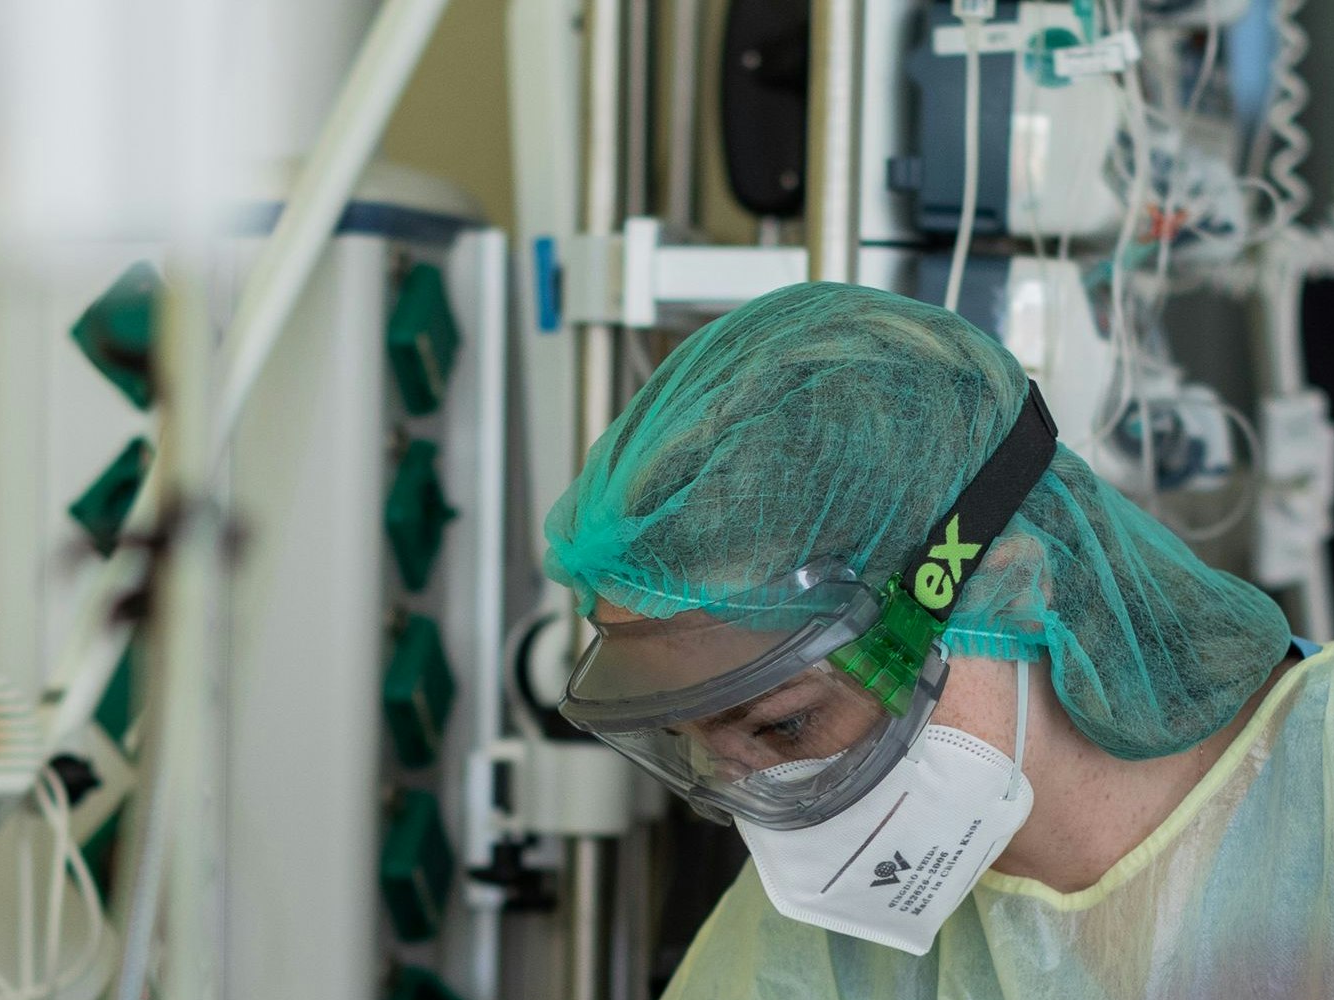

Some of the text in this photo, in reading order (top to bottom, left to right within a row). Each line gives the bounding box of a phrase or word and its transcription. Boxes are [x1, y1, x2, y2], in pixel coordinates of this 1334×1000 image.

[889, 845, 939, 908] QINGDAO WEIDA
[900, 851, 948, 911] GB2626-2006
[911, 893, 934, 915] Made
[931, 881, 942, 891] in
[940, 849, 963, 878] China
